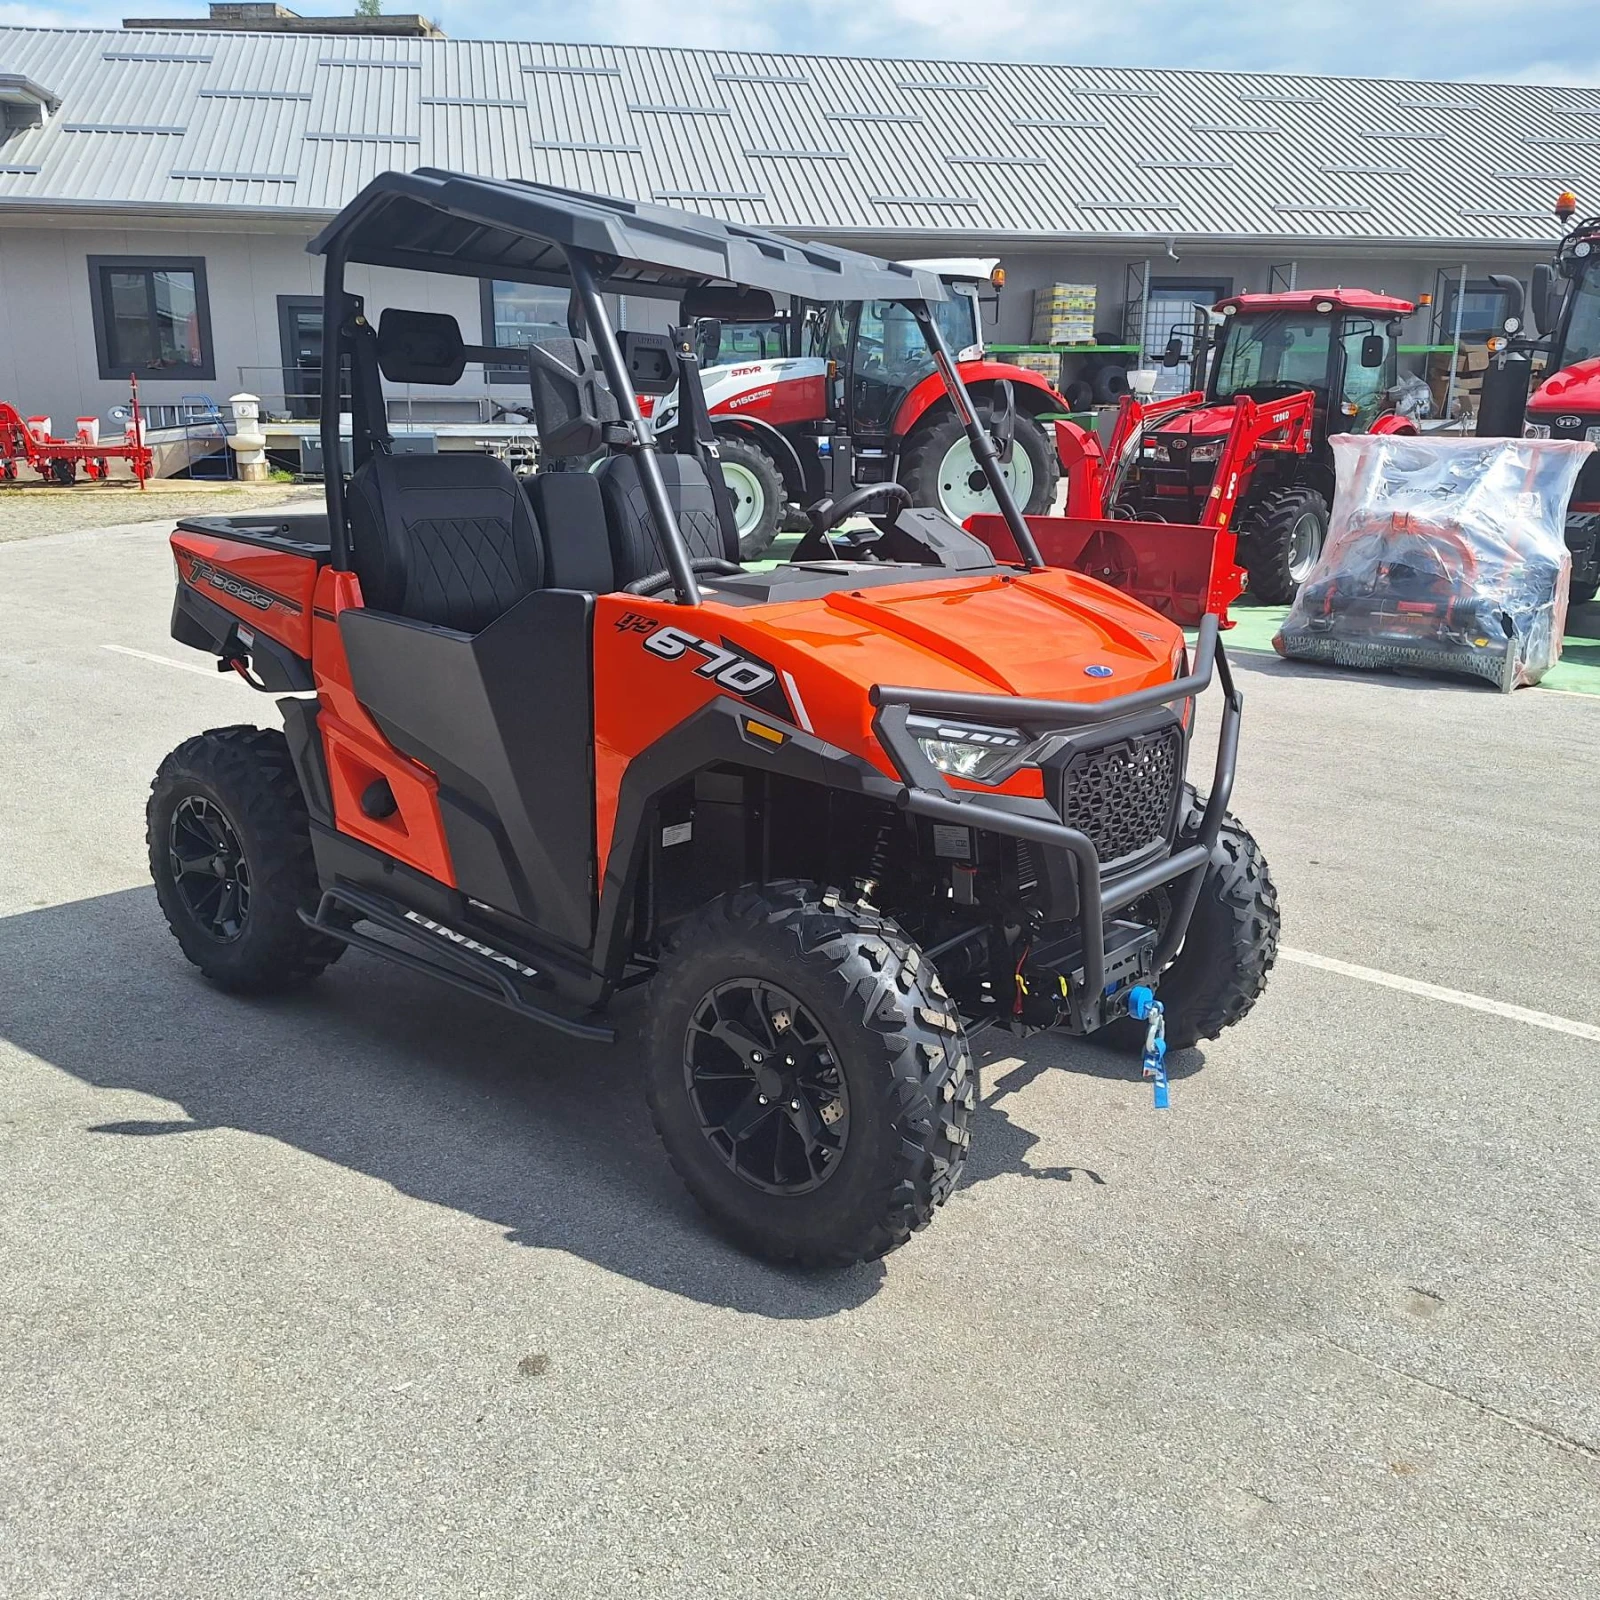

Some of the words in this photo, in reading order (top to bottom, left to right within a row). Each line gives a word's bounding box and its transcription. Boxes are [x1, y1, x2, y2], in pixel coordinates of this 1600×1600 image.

[731, 366, 762, 377] STEYR
[189, 559, 274, 610] T-BOSS
[614, 611, 659, 633] EPS
[642, 625, 776, 697] 670
[403, 910, 539, 977] LINHAI
